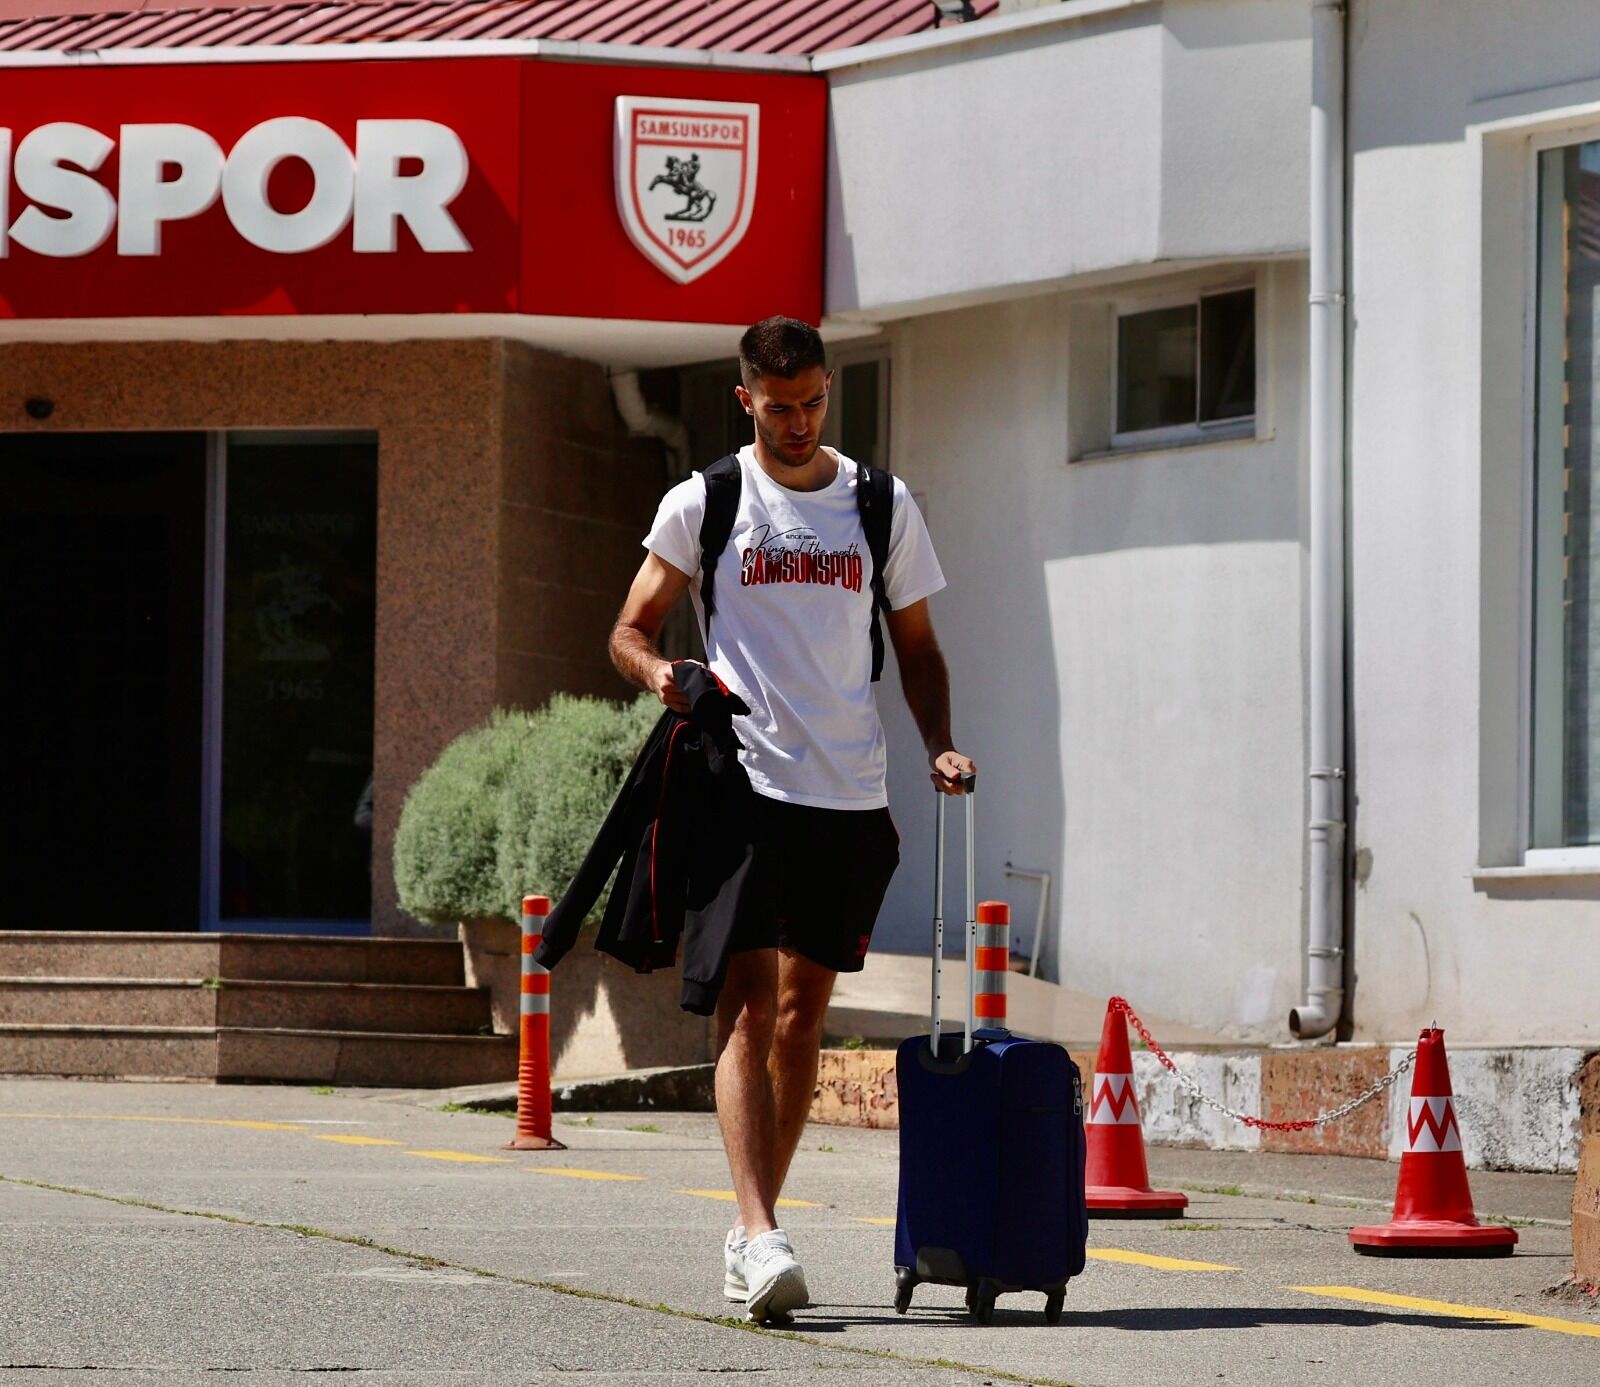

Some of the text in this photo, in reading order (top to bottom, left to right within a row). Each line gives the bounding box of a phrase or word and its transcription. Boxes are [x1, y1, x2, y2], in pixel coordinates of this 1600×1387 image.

[639, 120, 741, 140] SAMSUNSPOR
[0, 116, 473, 258] SPOR
[667, 228, 706, 248] 1965
[793, 540, 805, 558] of
[808, 541, 827, 556] the
[832, 542, 860, 557] north
[741, 548, 863, 593] SAMSUNSPOR
